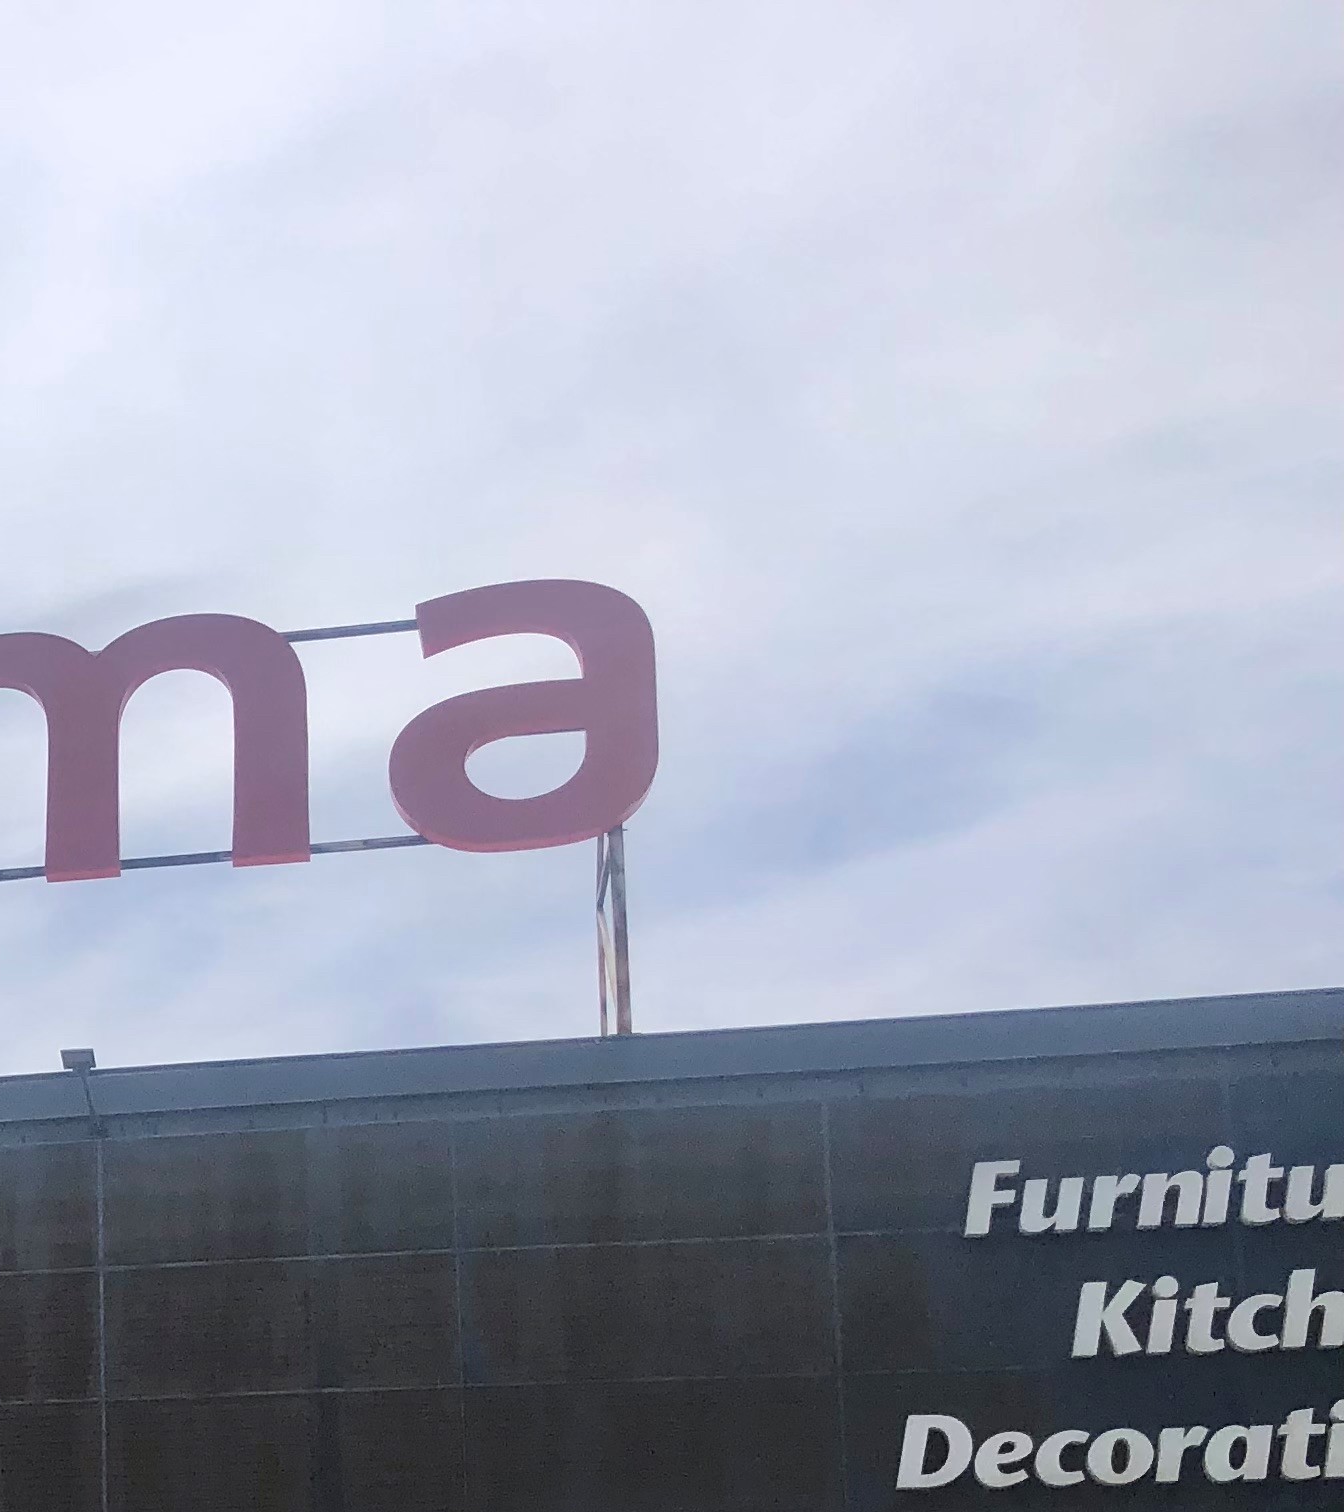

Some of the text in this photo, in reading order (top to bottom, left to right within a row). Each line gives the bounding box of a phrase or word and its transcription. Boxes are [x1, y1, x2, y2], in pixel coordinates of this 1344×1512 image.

[963, 1145, 1344, 1239] Furnitu
[1069, 1268, 1344, 1359] Kitch
[895, 1399, 1344, 1490] Decorati
